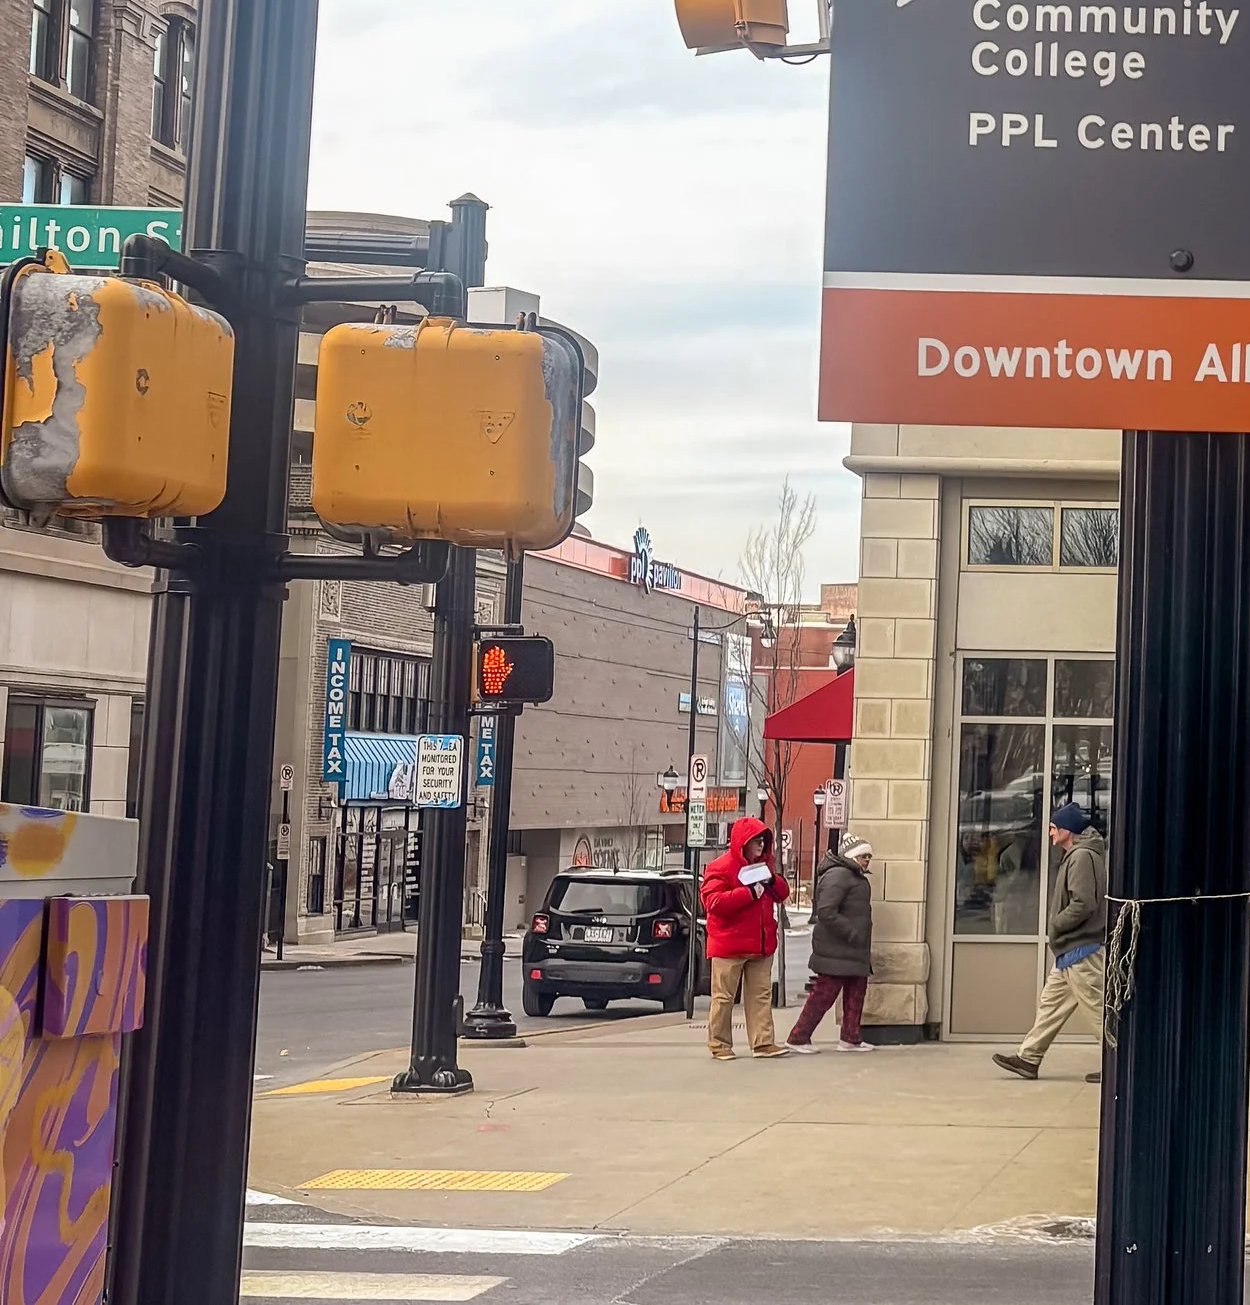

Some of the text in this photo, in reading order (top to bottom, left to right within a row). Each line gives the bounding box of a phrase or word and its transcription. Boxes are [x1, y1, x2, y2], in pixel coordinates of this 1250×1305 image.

[972, 42, 1146, 87] College
[969, 113, 1235, 153] PPL Center
[0, 216, 182, 253] ilton S
[918, 338, 1172, 381] Downtown
[327, 648, 345, 773] INCOME TAX
[422, 754, 457, 764] MONITORED
[424, 741, 437, 751] THIS
[479, 743, 493, 778] TAX
[422, 779, 453, 789] SECURITY
[423, 766, 455, 776] FOR YOUR
[419, 791, 431, 800] AND
